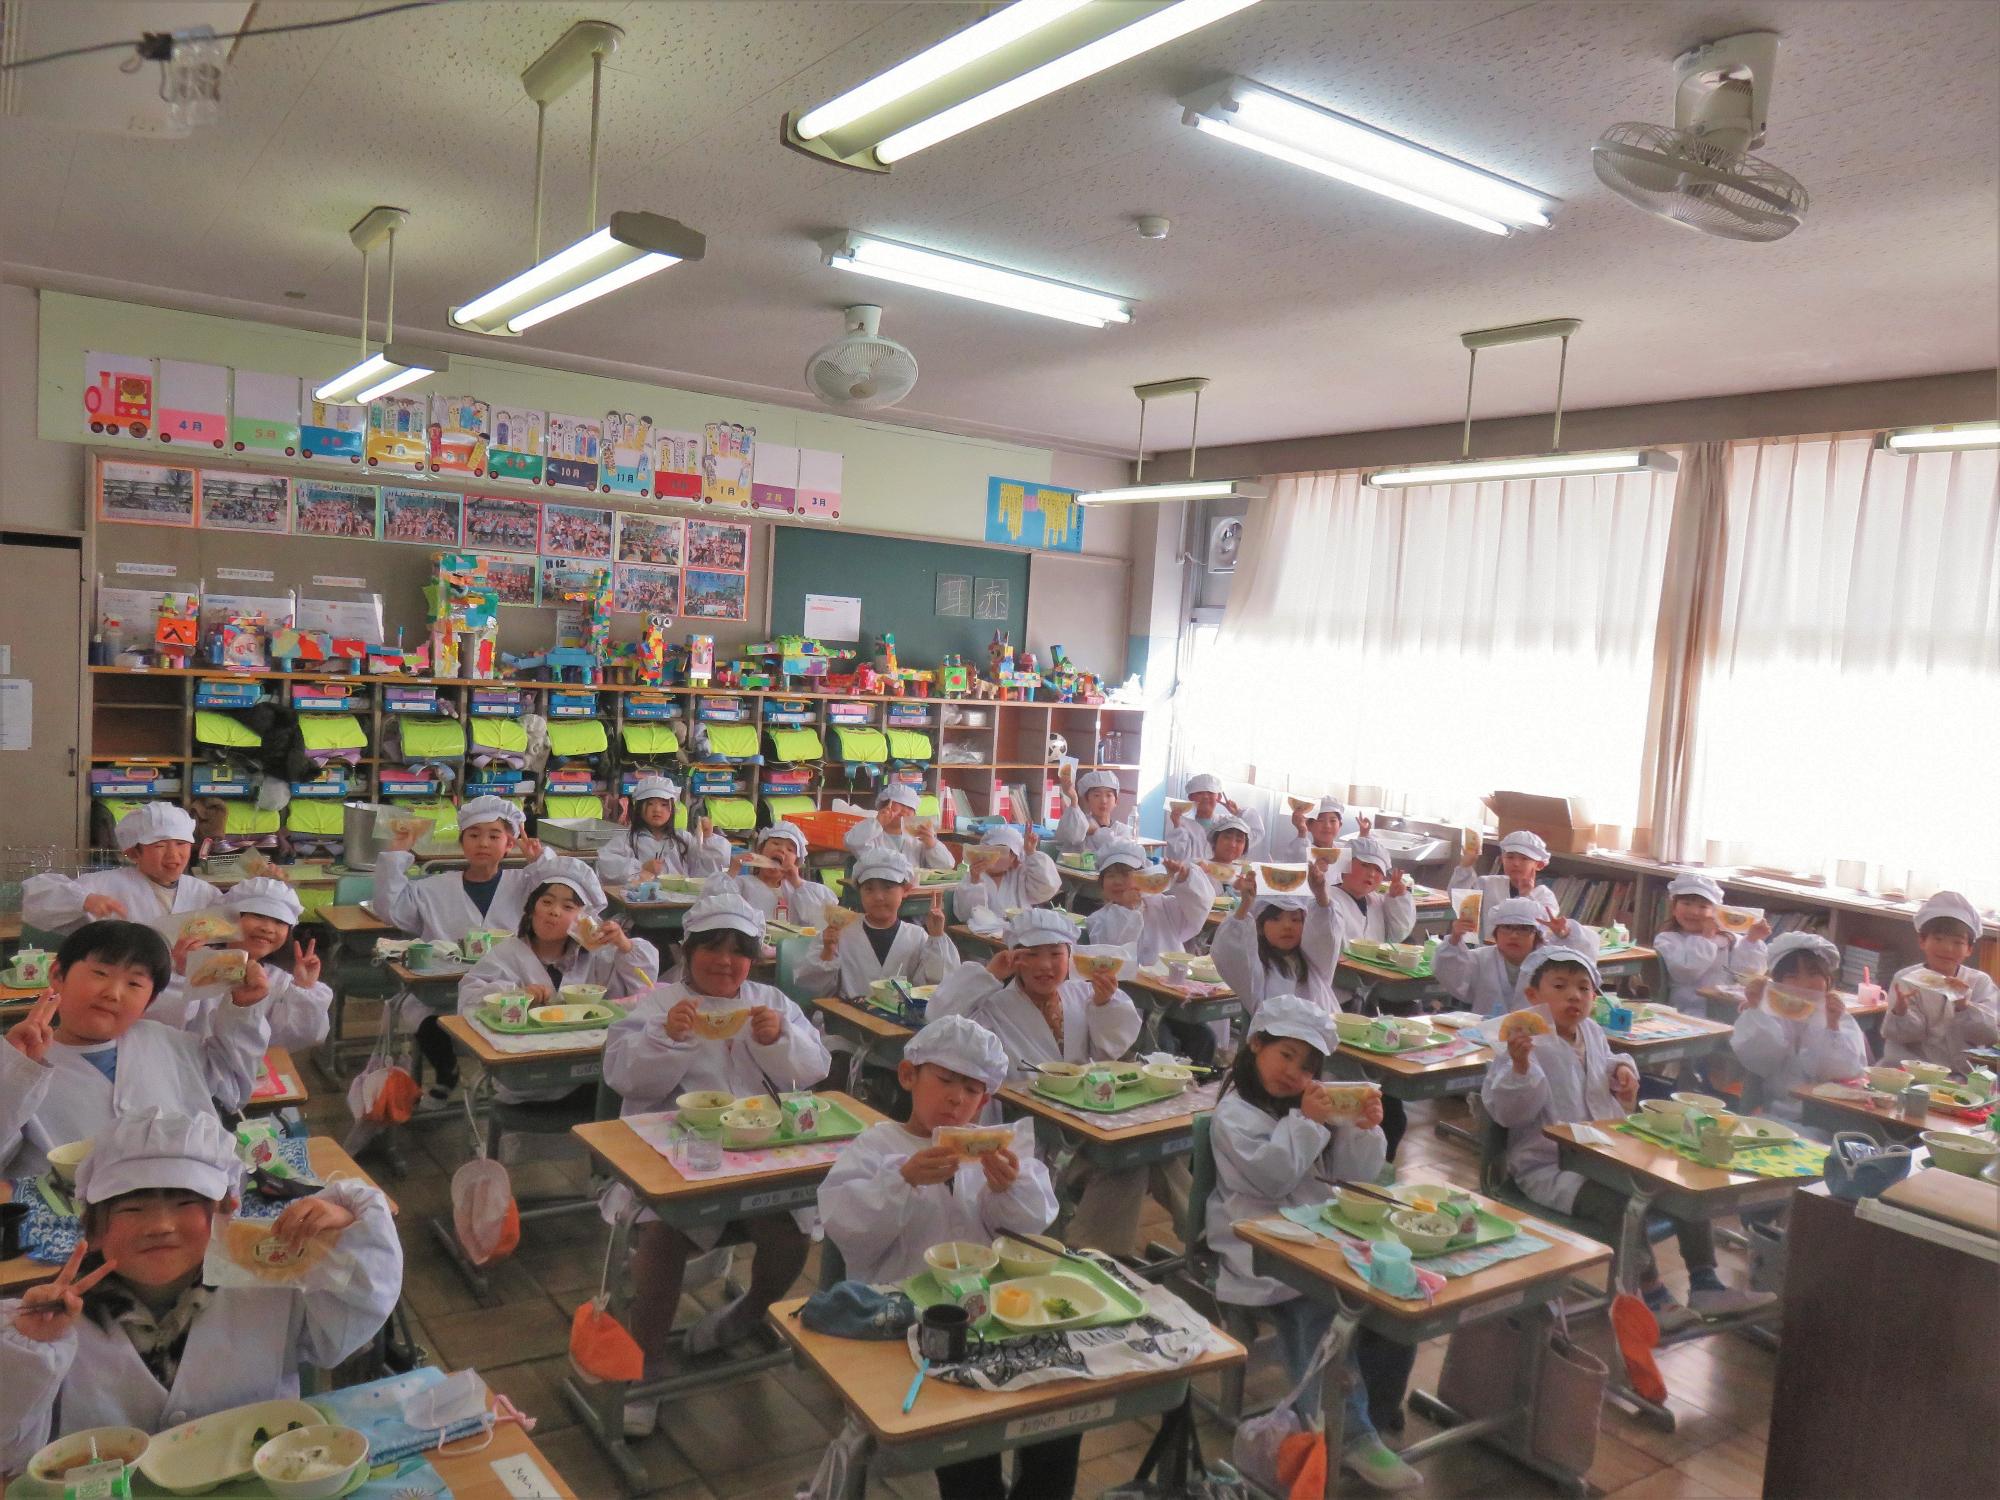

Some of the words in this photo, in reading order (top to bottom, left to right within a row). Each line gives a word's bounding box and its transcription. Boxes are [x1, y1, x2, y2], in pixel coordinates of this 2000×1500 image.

[179, 420, 202, 432] 4月
[561, 466, 580, 478] 10月
[617, 473, 634, 483] 11月
[720, 486, 735, 496] 1月
[812, 497, 826, 507] 3月
